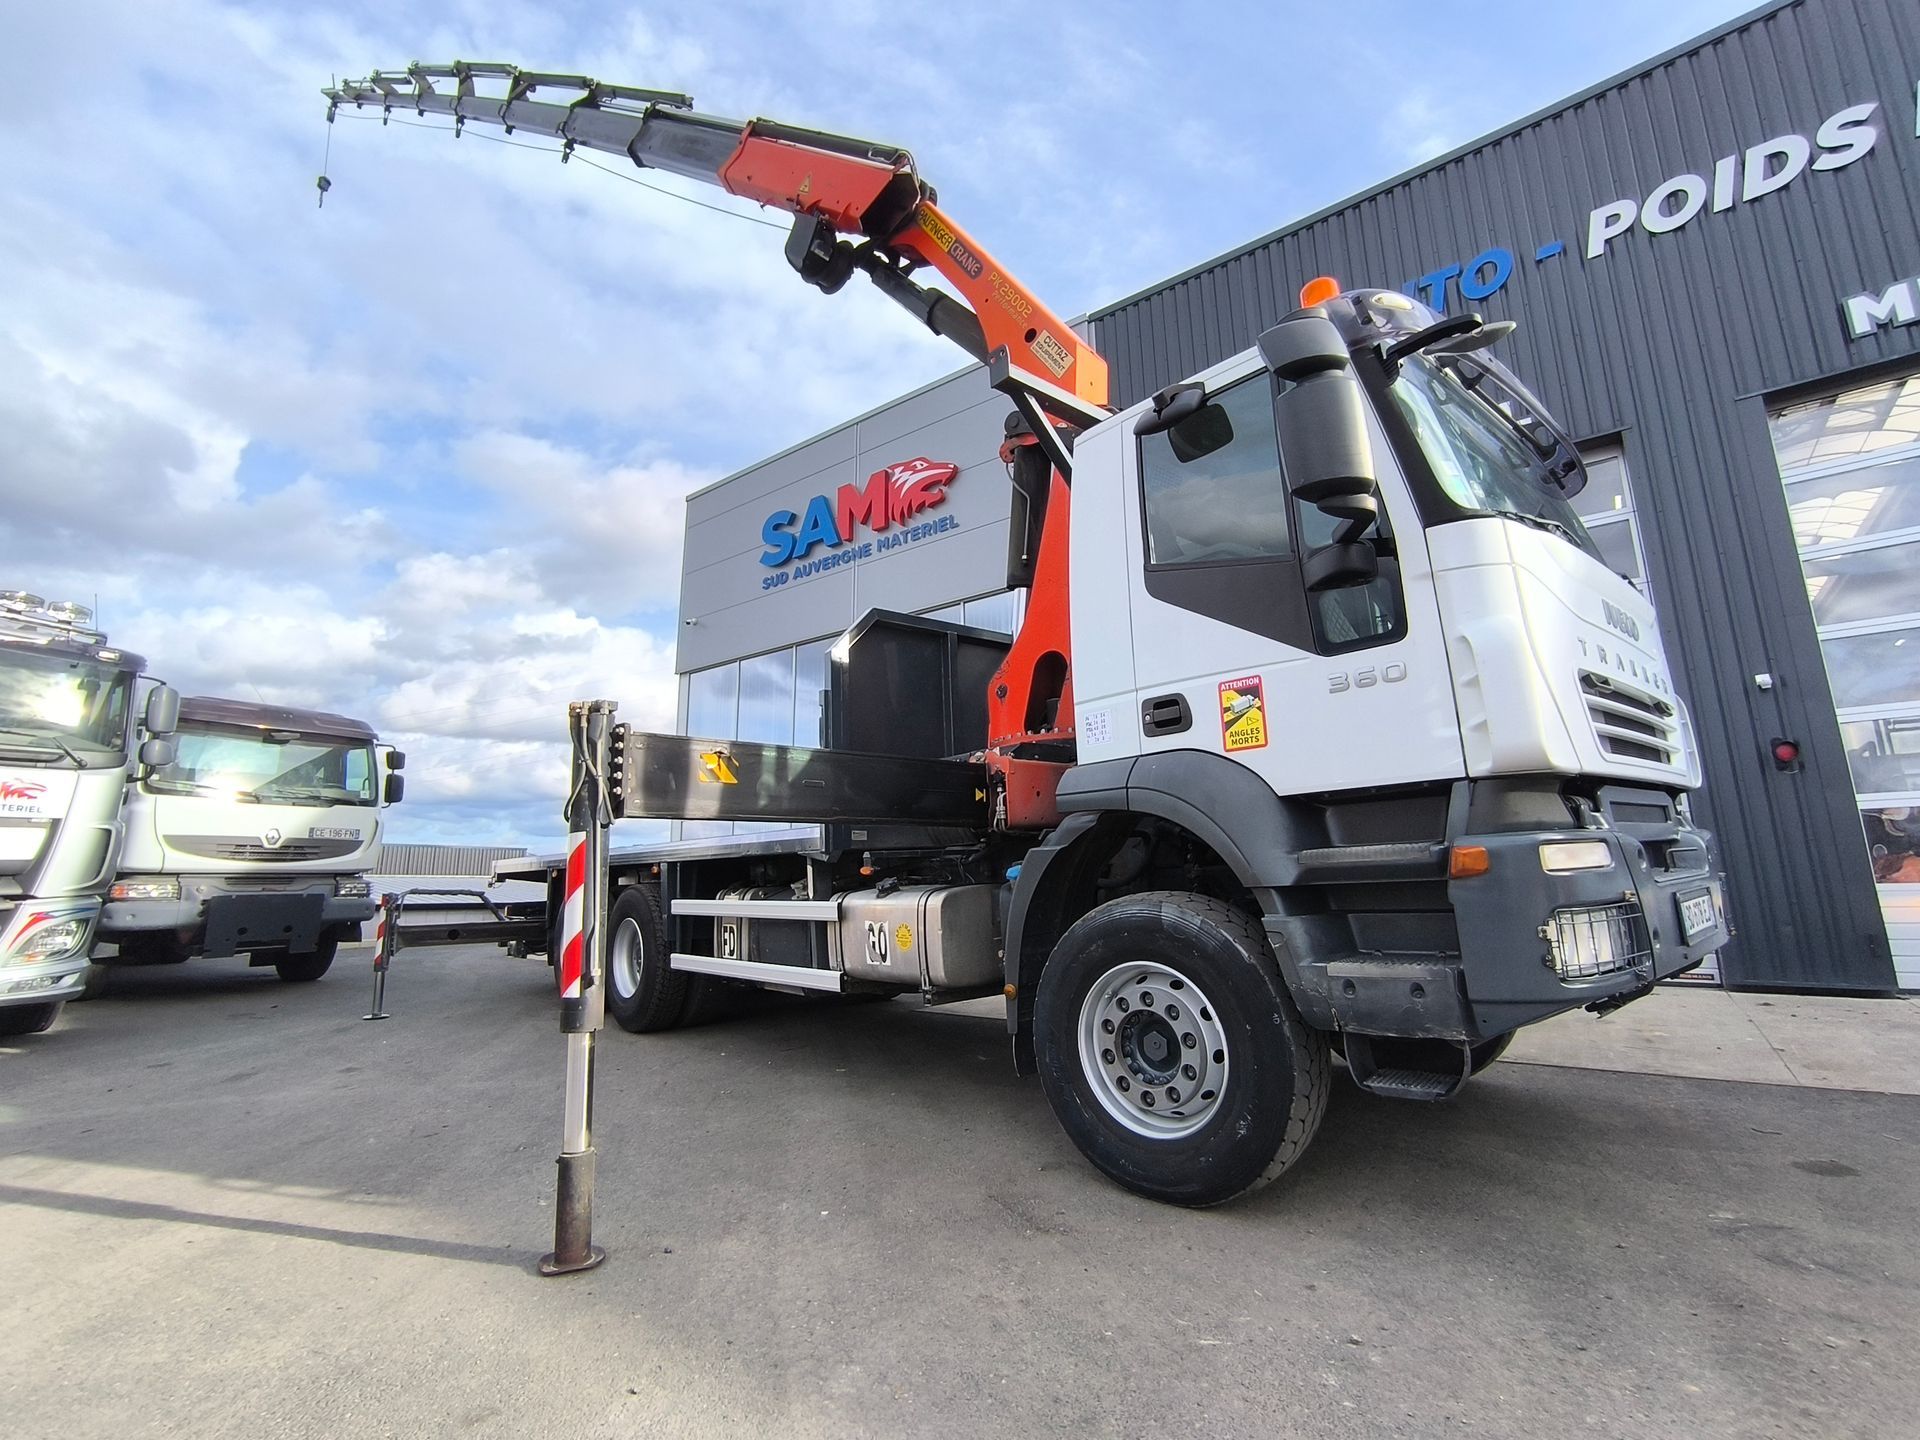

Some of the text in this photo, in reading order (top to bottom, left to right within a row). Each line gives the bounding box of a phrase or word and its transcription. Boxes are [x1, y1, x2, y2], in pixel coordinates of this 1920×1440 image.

[1402, 247, 1513, 313] TO
[1587, 101, 1880, 259] POIDS
[919, 207, 981, 276] PALFINGER CRANE
[988, 271, 1033, 318] PK 29002
[1043, 335, 1069, 362] CUTTAZ
[759, 469, 890, 568] SAM
[762, 514, 960, 590] SUD AUVERGNE MATERIEL
[1220, 676, 1260, 691] ATTENTION
[1327, 660, 1408, 694] 360
[1229, 726, 1261, 739] ANGLES
[1231, 735, 1261, 746] MORTS
